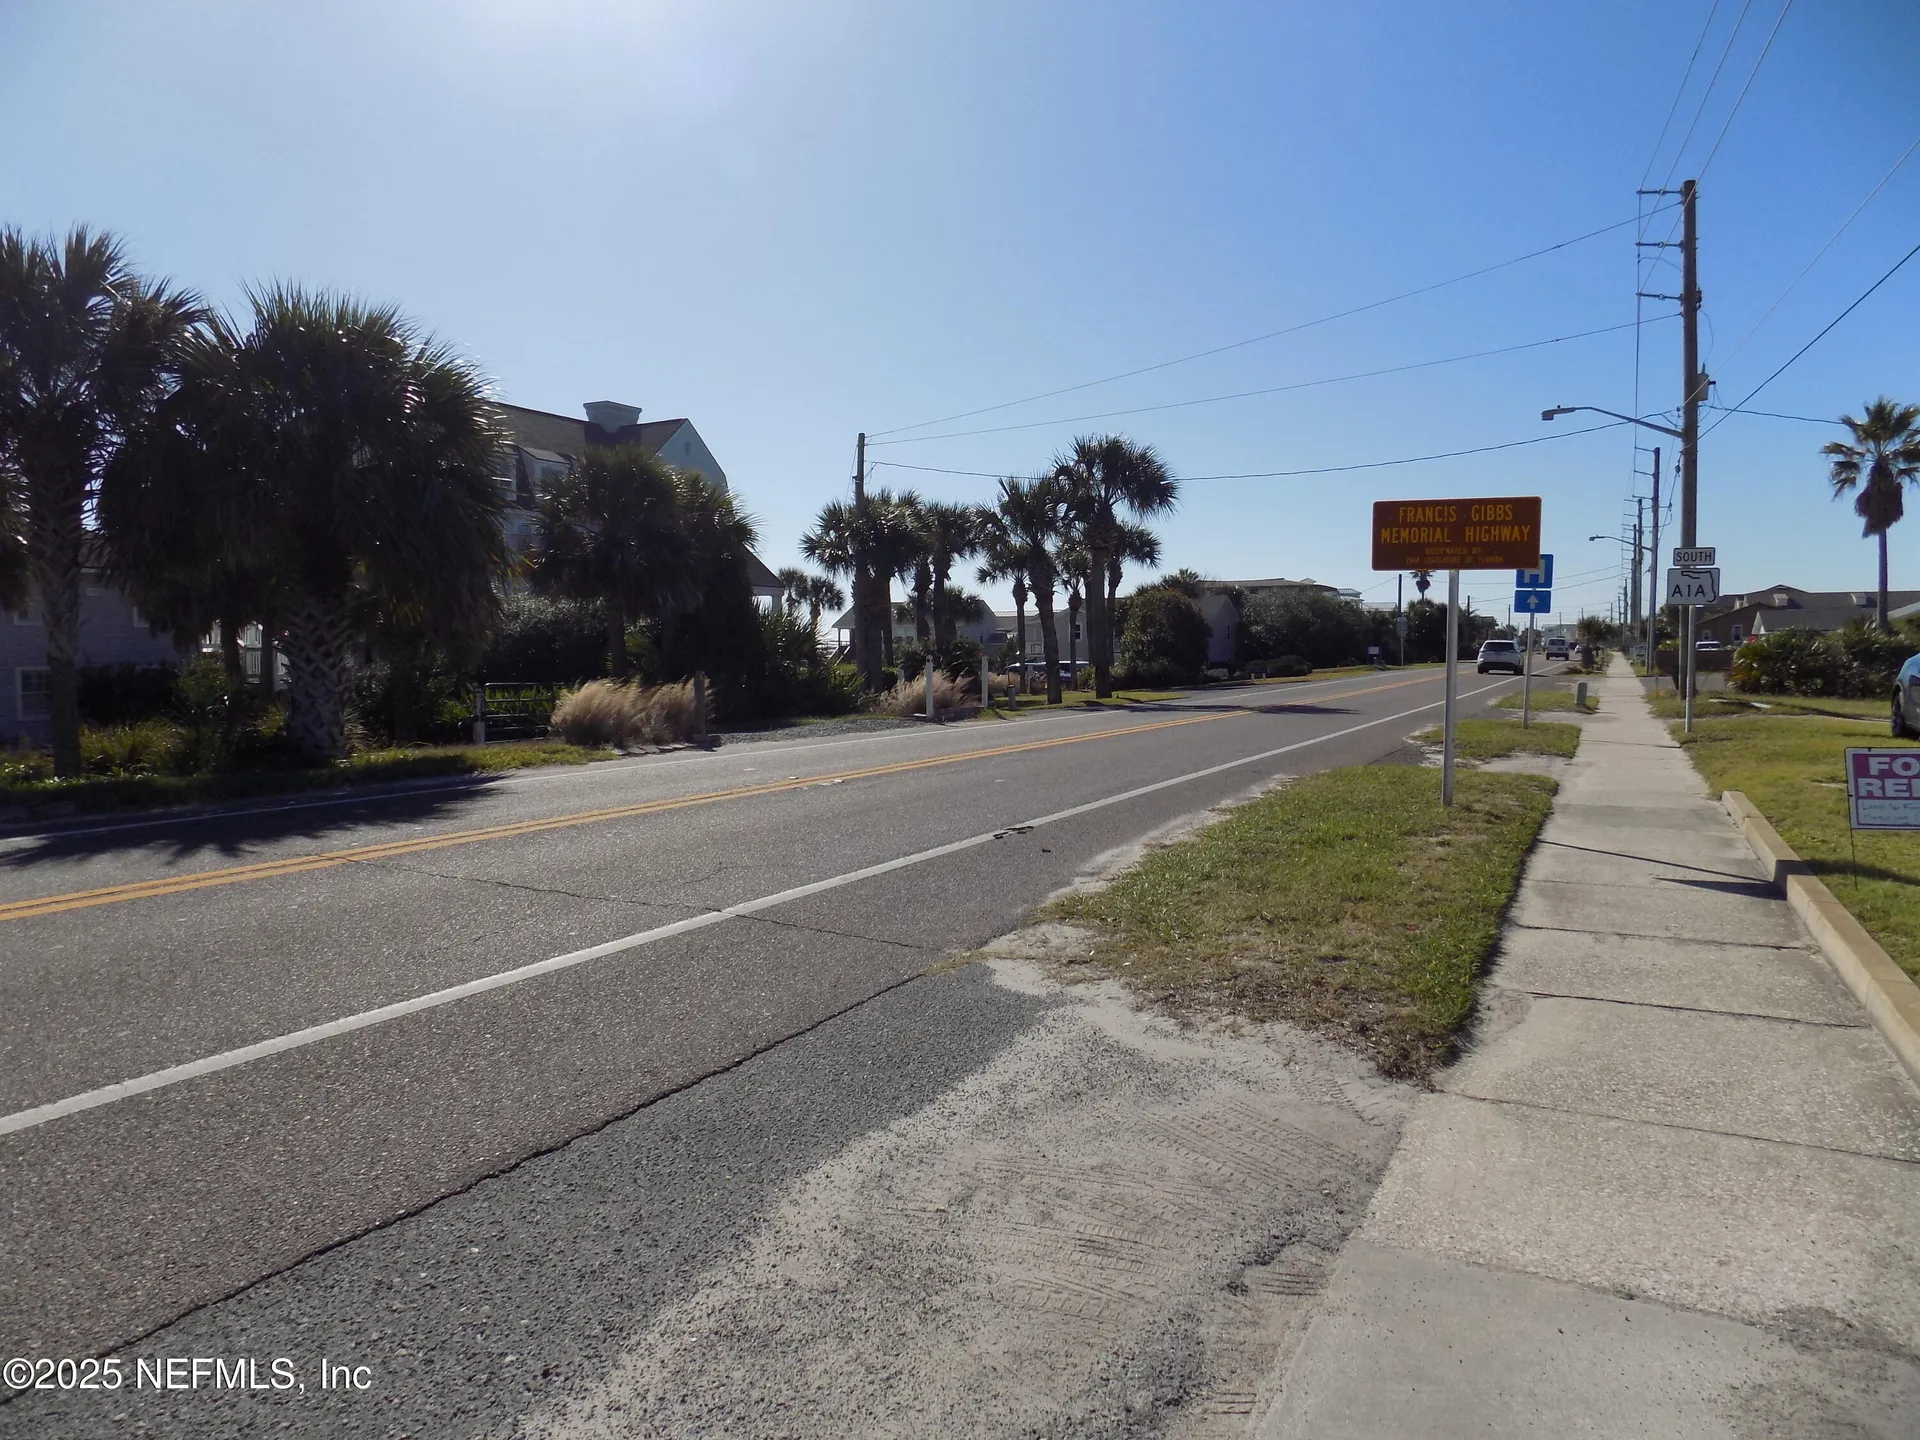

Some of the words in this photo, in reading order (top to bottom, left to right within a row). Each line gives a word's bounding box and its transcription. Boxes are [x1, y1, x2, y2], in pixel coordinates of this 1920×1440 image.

[1399, 505, 1457, 523] FRANCIS
[1471, 504, 1514, 521] GIBBS
[1381, 527, 1452, 544] MEMORIAL
[1465, 525, 1531, 543] HIGHWAY
[1675, 551, 1712, 562] SOUTH
[1671, 584, 1706, 598] A1A
